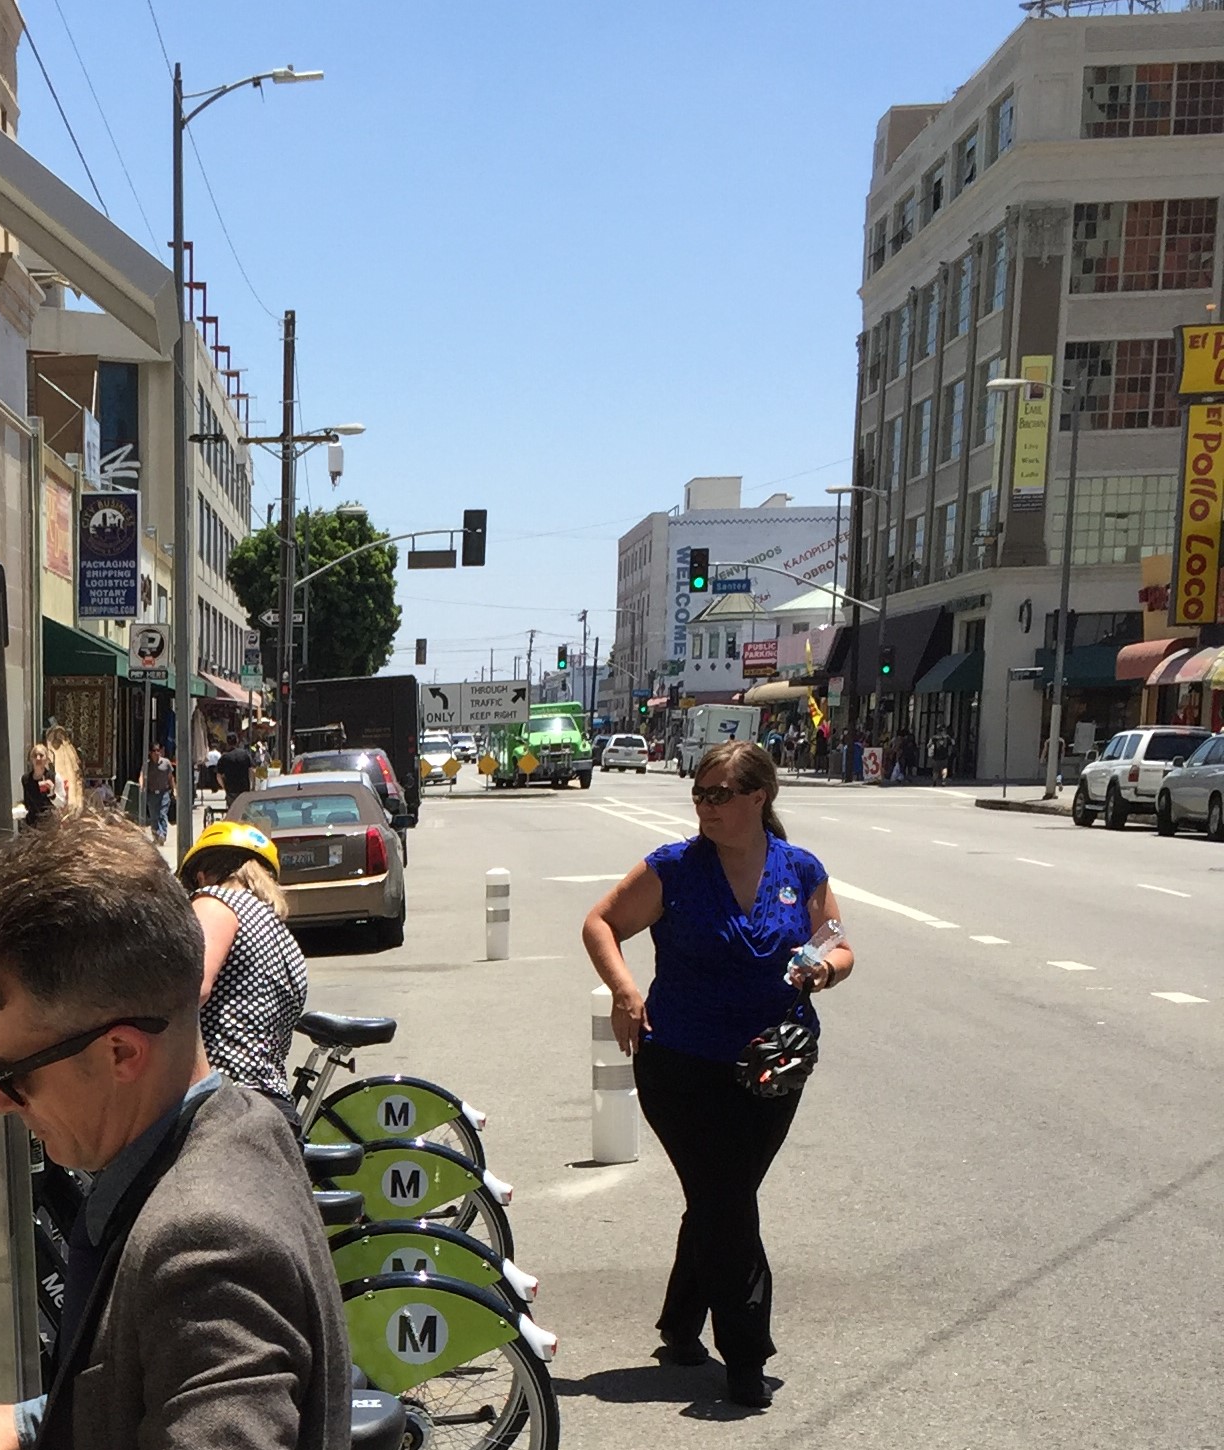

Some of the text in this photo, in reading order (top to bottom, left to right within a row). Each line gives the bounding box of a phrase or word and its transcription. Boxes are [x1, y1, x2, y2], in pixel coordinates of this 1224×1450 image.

[1189, 332, 1208, 349] El
[1189, 431, 1222, 522] Pollo
[81, 560, 136, 569] PACKAGING
[86, 570, 131, 578] SHIPPING
[1182, 533, 1215, 621] Loco
[85, 579, 135, 588] LOGISTICS
[716, 581, 748, 591] Santee
[89, 589, 127, 597] NOTARY
[673, 545, 691, 656] WELCOME
[747, 642, 777, 651] PUBLIC
[470, 685, 508, 695] THROUGH
[470, 698, 503, 708] TRAFFIC
[426, 712, 456, 723] ONLY
[470, 710, 518, 721] KEEP RIGHT
[384, 1102, 409, 1126] M
[390, 1169, 420, 1198] M
[398, 1315, 437, 1353] M
